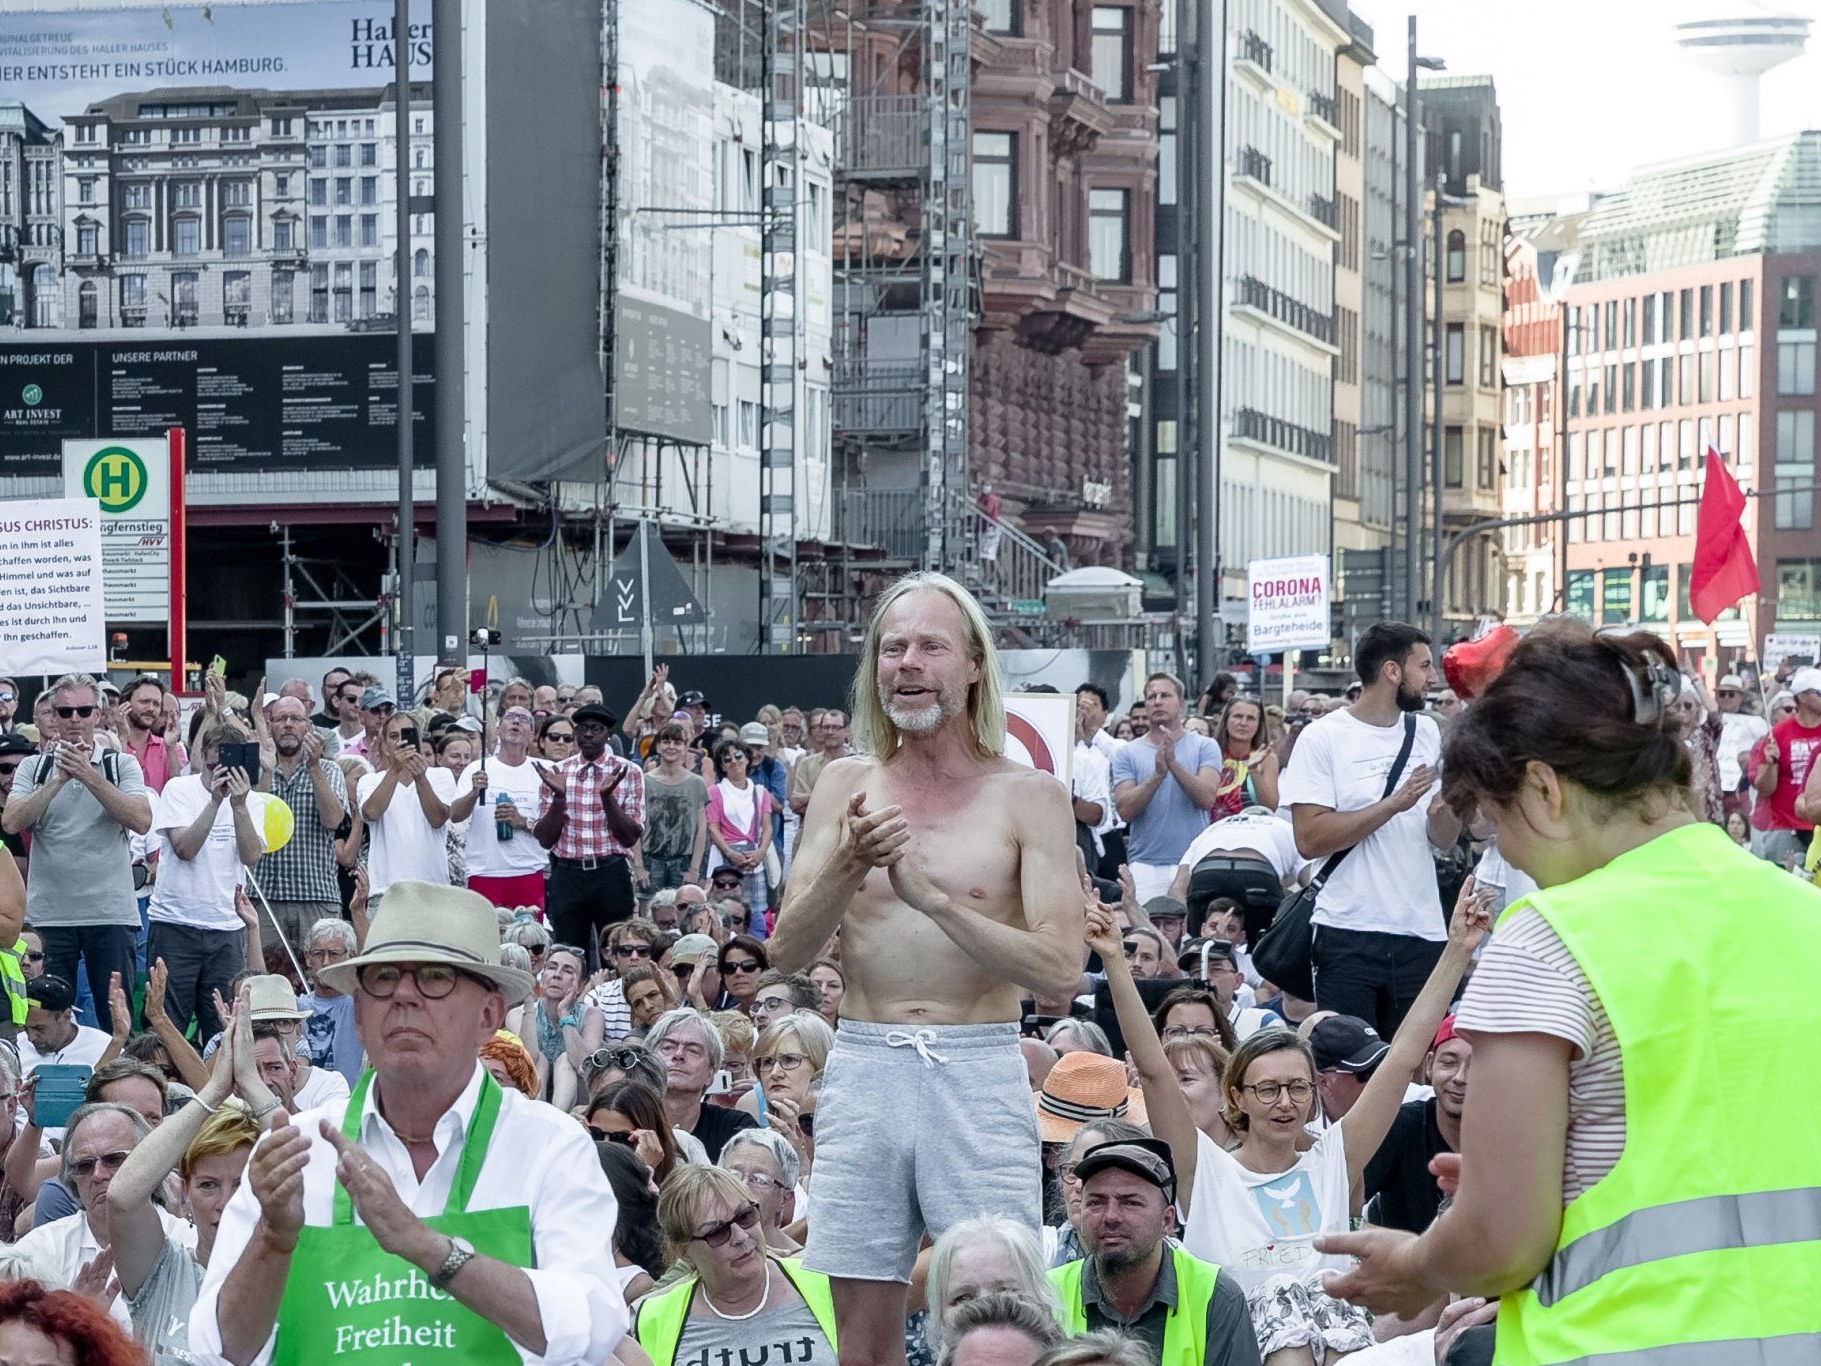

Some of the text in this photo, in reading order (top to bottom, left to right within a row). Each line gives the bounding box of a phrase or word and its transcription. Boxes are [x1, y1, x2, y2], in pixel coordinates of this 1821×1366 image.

[351, 19, 432, 41] Haler
[70, 44, 89, 55] DES
[92, 43, 130, 54] HALLER
[131, 42, 169, 52] HAUSES
[28, 64, 110, 81] ENTSTEHT
[115, 62, 141, 78] EIN
[145, 57, 198, 77] STÜCK
[202, 57, 288, 73] HAMBURG.
[10, 354, 52, 365] PROJEKT
[54, 354, 73, 364] DER
[112, 351, 198, 363] UNSERE PARTNER
[4, 408, 62, 419] ART INVEST
[25, 518, 93, 532] CHRISTUS:
[100, 523, 163, 535] ngfernstieg
[10, 542, 19, 550] in
[21, 541, 38, 550] Ihm
[41, 540, 51, 549] ist
[54, 539, 74, 548] alles
[142, 538, 164, 546] HVV
[34, 555, 72, 565] worden,
[74, 554, 91, 562] was
[0, 572, 34, 582] Himmel
[37, 570, 54, 579] und
[56, 571, 74, 579] was
[76, 568, 91, 577] auf
[14, 586, 29, 596] ist,
[31, 585, 46, 595] das
[48, 583, 90, 594] Sichtbare
[1253, 577, 1321, 599] CORONA
[6, 602, 22, 611] das
[24, 599, 81, 610] Unsichtbare,
[1253, 595, 1322, 611] FEHLALARM?
[11, 616, 22, 626] ist
[24, 615, 50, 625] durch
[53, 615, 67, 624] Ihn
[69, 614, 87, 623] und
[1254, 620, 1323, 636] Bargteheide
[4, 632, 18, 641] Ihn
[20, 631, 72, 643] geschaffen.
[703, 714, 722, 728] SE
[324, 1269, 456, 1310] Wahrh
[333, 1315, 457, 1354] Freiheit
